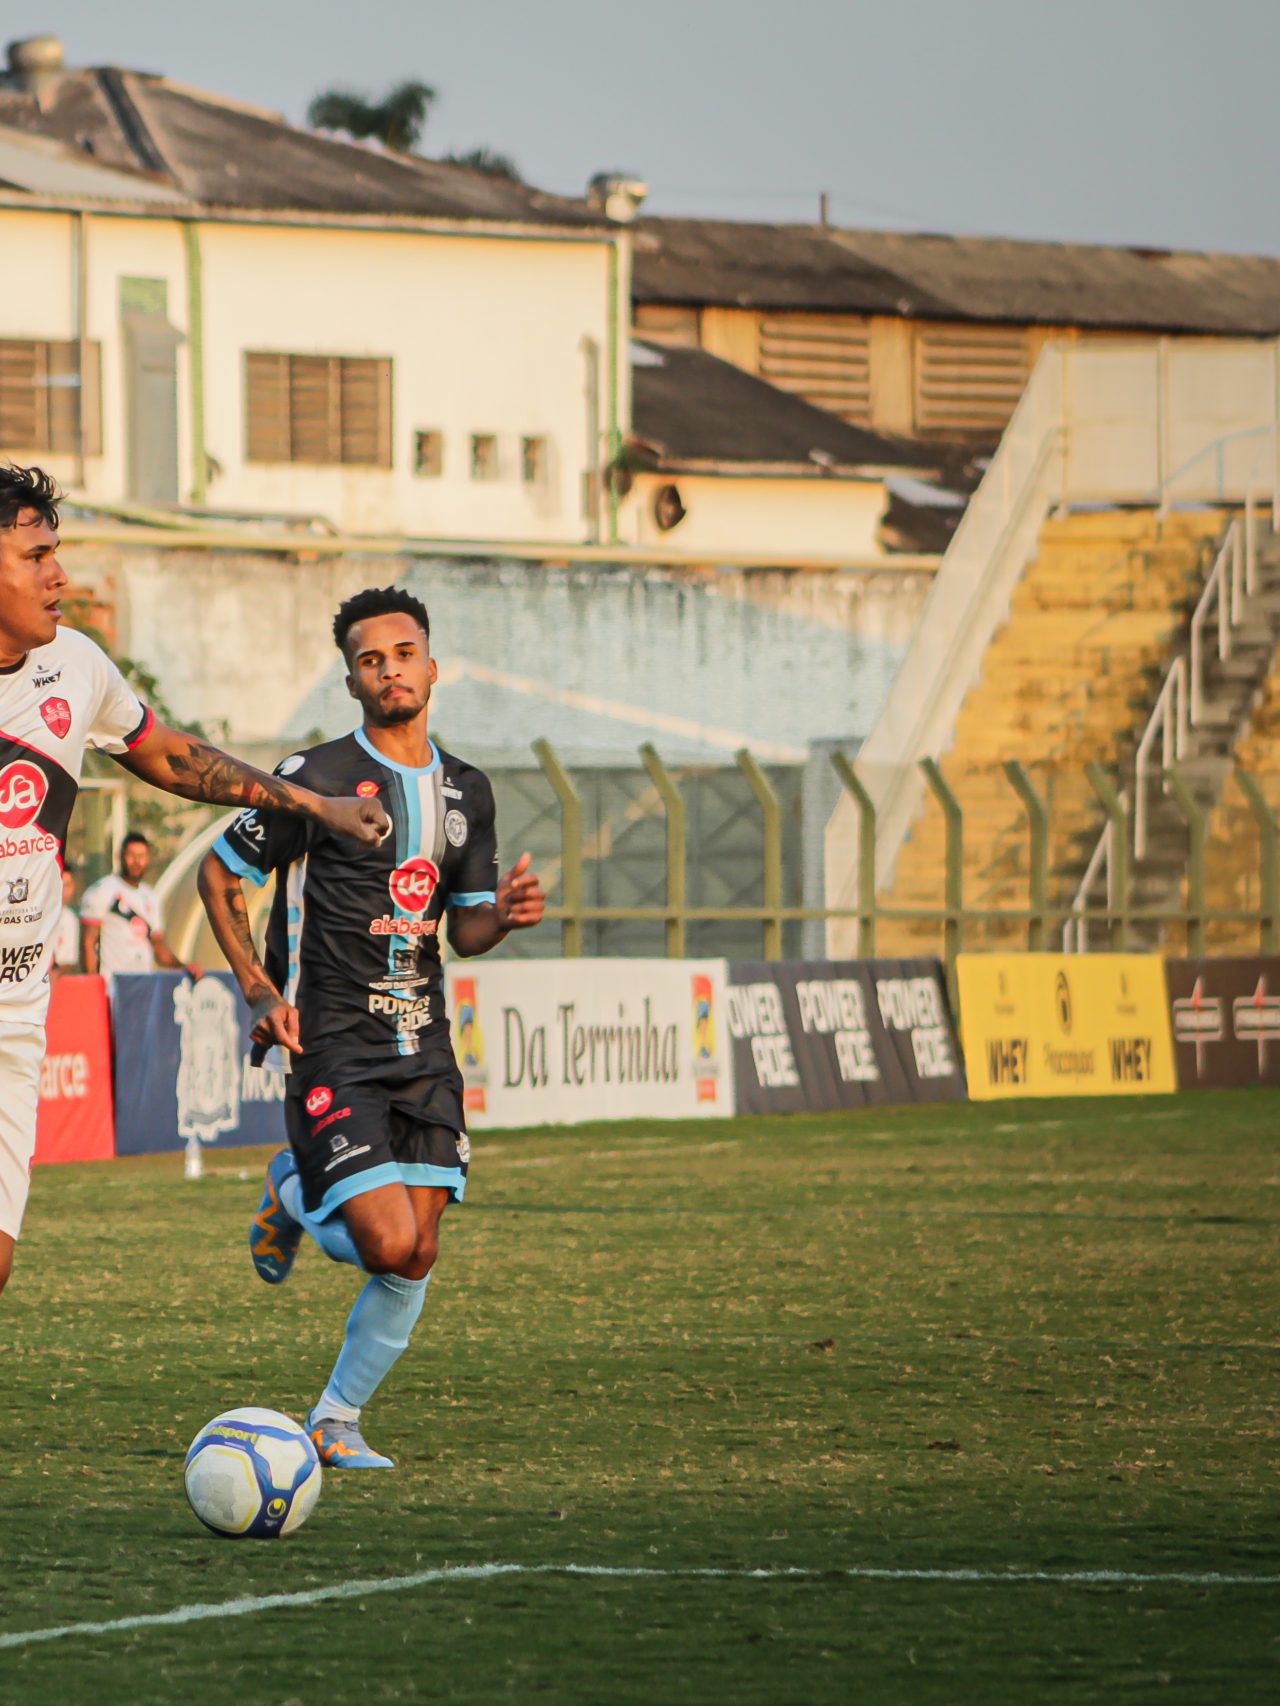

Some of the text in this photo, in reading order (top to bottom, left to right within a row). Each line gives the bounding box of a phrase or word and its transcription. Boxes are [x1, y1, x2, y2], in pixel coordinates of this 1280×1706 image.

[32, 671, 61, 688] WHEY
[4, 915, 21, 925] DAS
[726, 982, 787, 1038] OWER
[796, 979, 868, 1034] POWER
[876, 976, 946, 1031] POWER
[503, 995, 679, 1089] Da Terrinha
[751, 1033, 800, 1087] ADE
[834, 1030, 880, 1082] ADE
[911, 1026, 956, 1079] ADE
[986, 1037, 1029, 1085] WHEY
[1108, 1037, 1152, 1083] WHEY
